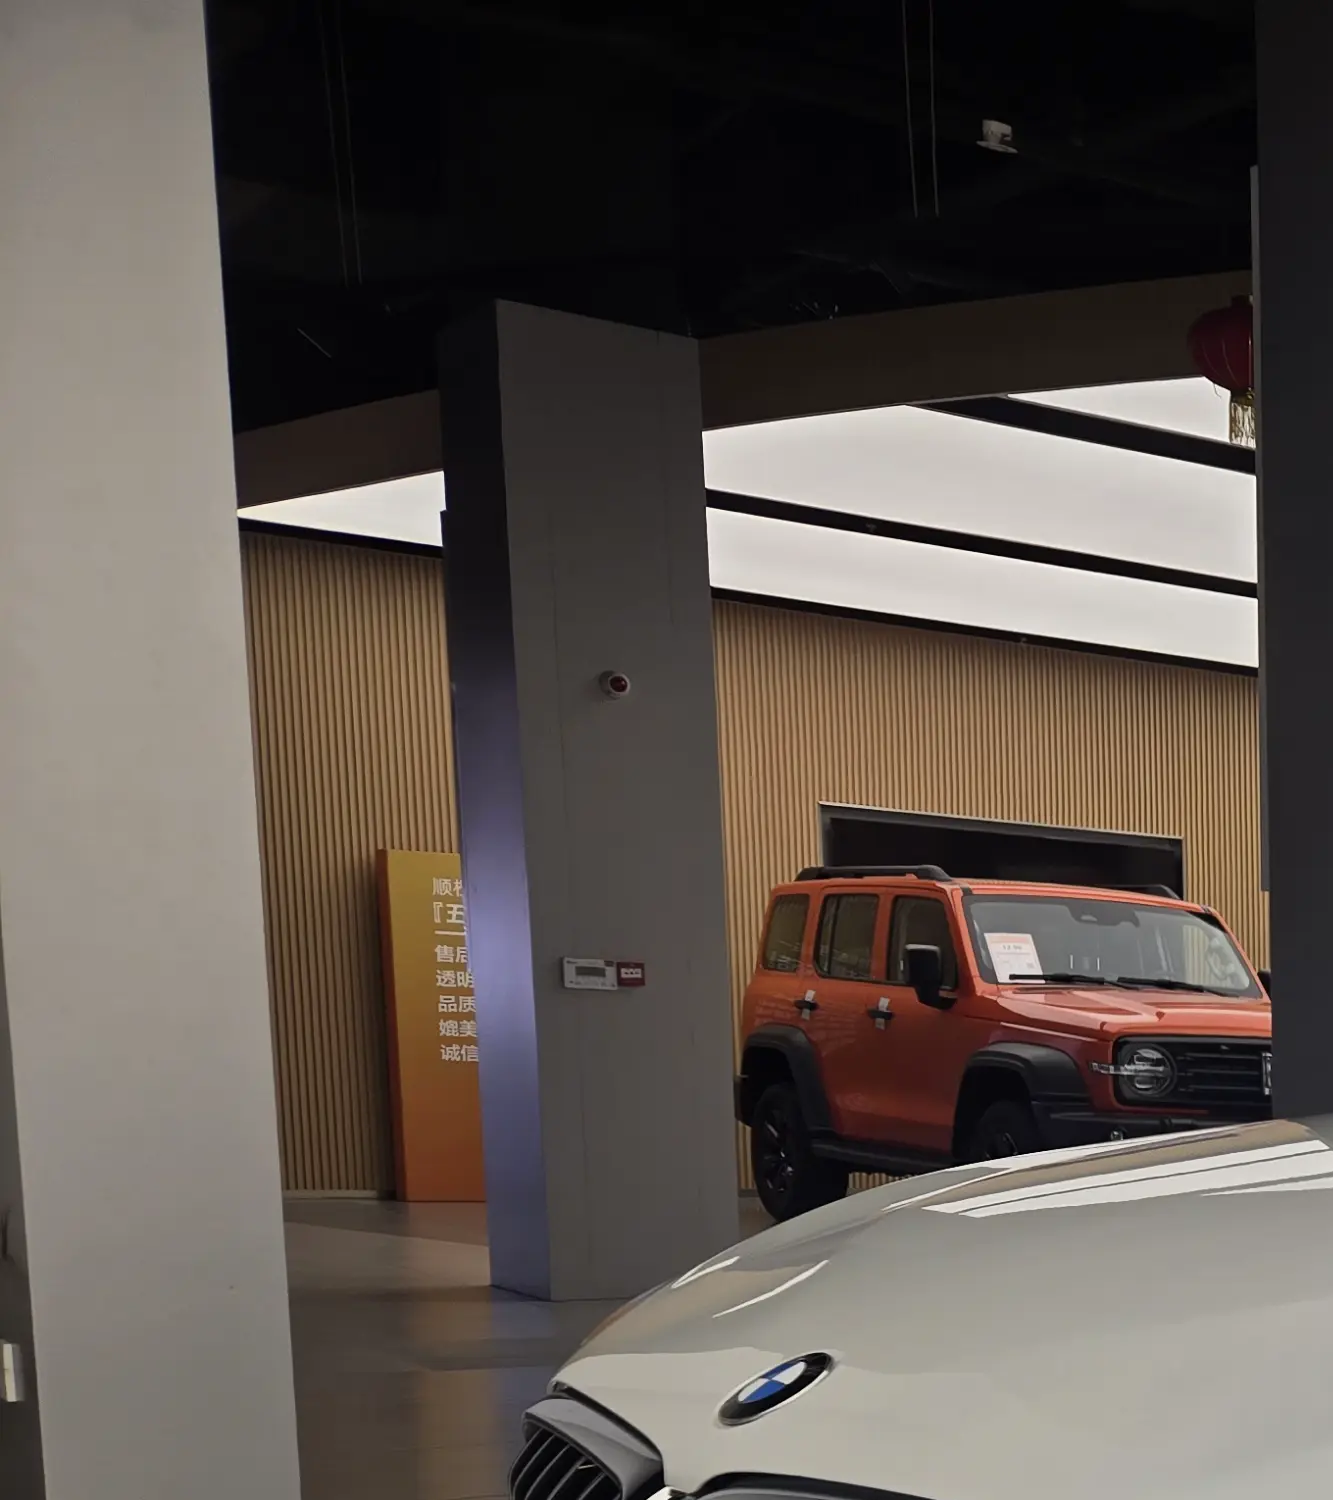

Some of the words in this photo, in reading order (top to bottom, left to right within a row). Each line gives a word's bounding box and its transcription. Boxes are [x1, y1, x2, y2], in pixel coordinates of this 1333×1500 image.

[438, 995, 476, 1013] 品质
[438, 1018, 477, 1037] 媲美
[440, 1043, 479, 1062] 诚信
